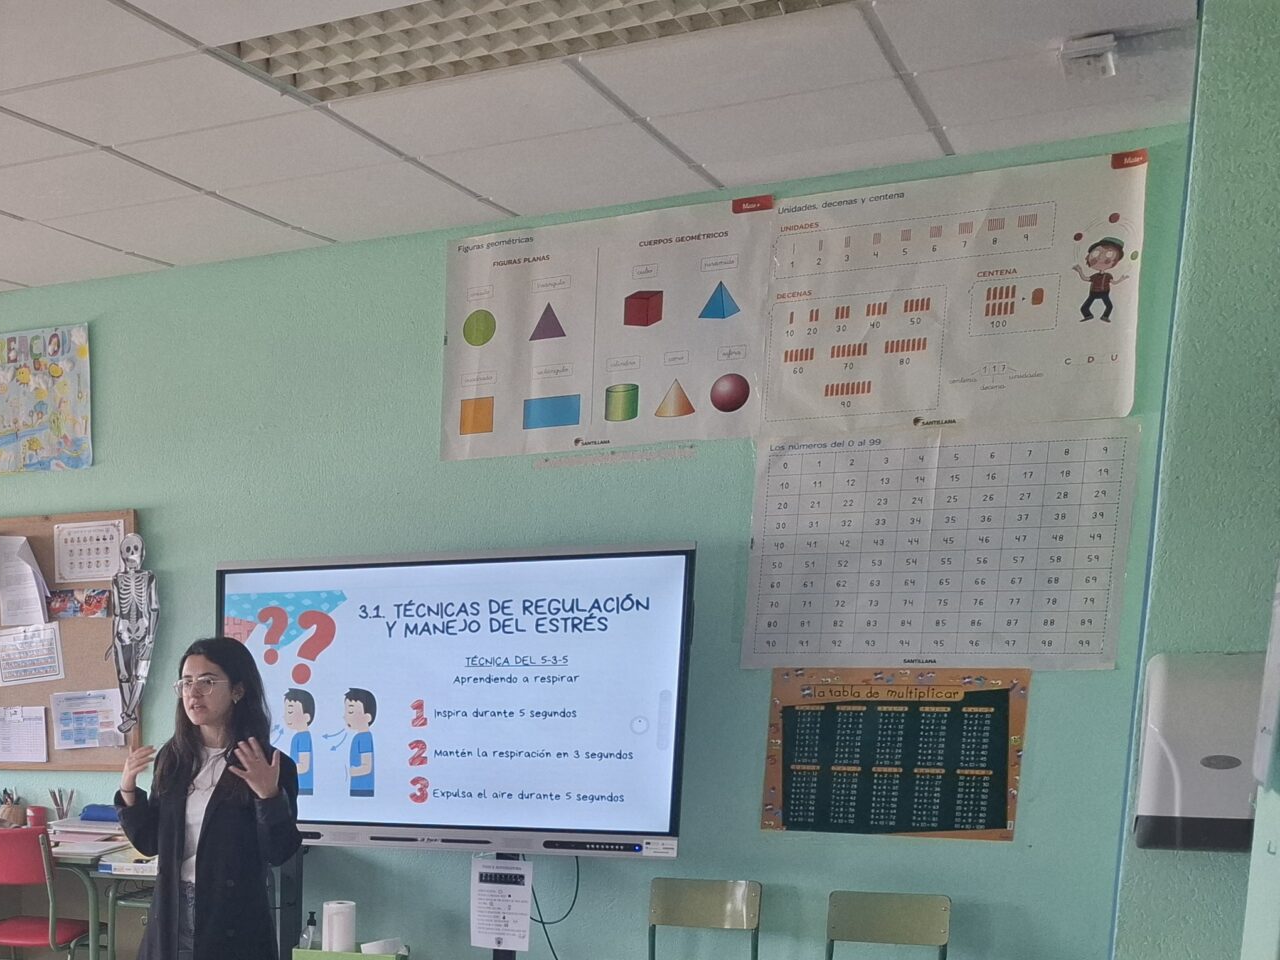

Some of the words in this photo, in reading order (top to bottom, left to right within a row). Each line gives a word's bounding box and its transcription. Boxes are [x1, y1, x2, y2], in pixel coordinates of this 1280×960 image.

[778, 203, 819, 215] Unidades,
[821, 198, 858, 209] decenas
[860, 197, 867, 206] y
[869, 191, 905, 202] centena
[780, 221, 819, 232] UNIDADES
[458, 243, 484, 253] Figuras
[486, 236, 534, 249] geométricas
[639, 237, 673, 247] CUERPOS
[675, 230, 729, 243] GEOMÉTRICOS
[816, 257, 822, 266] 2
[844, 254, 850, 262] 3
[873, 251, 879, 259] 4
[902, 248, 908, 256] 5
[932, 245, 937, 253] 6
[962, 240, 967, 249] 7
[992, 237, 998, 245] 8
[1023, 233, 1029, 242] 9
[493, 259, 521, 267] FIGURAS
[523, 255, 550, 263] PLANAS
[977, 268, 1018, 278] CENTENA
[776, 289, 812, 299] DECENAS
[786, 329, 794, 337] 10
[807, 327, 818, 335] 20
[836, 324, 847, 332] 30
[869, 321, 880, 329] 40
[909, 317, 921, 326] 50
[990, 319, 1007, 328] 100
[793, 367, 803, 375] 60
[843, 362, 854, 371] 70
[899, 358, 911, 366] 80
[1111, 354, 1117, 362] U
[841, 400, 851, 408] 90
[770, 443, 786, 452] Los
[788, 441, 827, 450] números
[830, 439, 845, 449] del
[848, 439, 855, 447] 0
[858, 438, 867, 447] al
[869, 437, 881, 447] 99
[817, 460, 821, 468] 1
[918, 455, 924, 463] 4
[954, 453, 959, 461] 5
[990, 451, 995, 459] 6
[1064, 448, 1070, 456] 8
[1102, 446, 1108, 454] 9
[779, 482, 789, 490] 10
[846, 479, 856, 487] 12
[880, 477, 890, 485] 13
[950, 474, 960, 482] 15
[986, 472, 996, 480] 16
[1023, 471, 1033, 479] 17
[1060, 470, 1071, 478] 18
[1098, 468, 1109, 476] 19
[777, 502, 788, 510] 20
[810, 501, 821, 509] 21
[843, 499, 854, 507] 22
[877, 498, 888, 506] 23
[946, 495, 958, 503] 25
[982, 494, 994, 502] 26
[1019, 492, 1031, 501] 27
[1056, 491, 1069, 499] 28
[1094, 490, 1107, 498] 29
[359, 605, 385, 620] 3.1.
[393, 601, 480, 618] TÉCNICAS
[488, 599, 515, 616] DE
[522, 593, 650, 616] REGULACIÓN
[385, 621, 396, 638] Y
[404, 618, 482, 637] MANEJO
[490, 618, 526, 634] DEL
[535, 613, 609, 634] ESTRÉS
[465, 655, 510, 667] TÉCNICA
[515, 654, 536, 666] DEL
[540, 654, 569, 666] 5-3-5
[453, 673, 518, 685] Aprendiendo
[523, 675, 529, 683] a
[534, 673, 580, 685] respirar
[813, 687, 825, 698] la
[829, 688, 861, 699] tabla
[866, 688, 879, 698] de
[887, 685, 958, 701] multiplicar
[410, 699, 428, 728] 1
[434, 708, 468, 720] Inspira
[472, 708, 515, 718] durante
[519, 709, 525, 718] 5
[529, 708, 577, 720] segundos
[409, 739, 428, 767] 2
[434, 748, 473, 759] Mantén
[476, 748, 487, 759] la
[492, 748, 552, 761] respiración
[556, 750, 570, 759] en
[573, 749, 580, 760] 3
[585, 750, 633, 762] segundos
[409, 776, 429, 803] 3
[433, 788, 475, 801] Expulsa
[477, 789, 488, 799] el
[492, 789, 514, 800] aire
[518, 790, 561, 802] durante
[565, 791, 572, 801] 5
[576, 791, 624, 805] segundos
